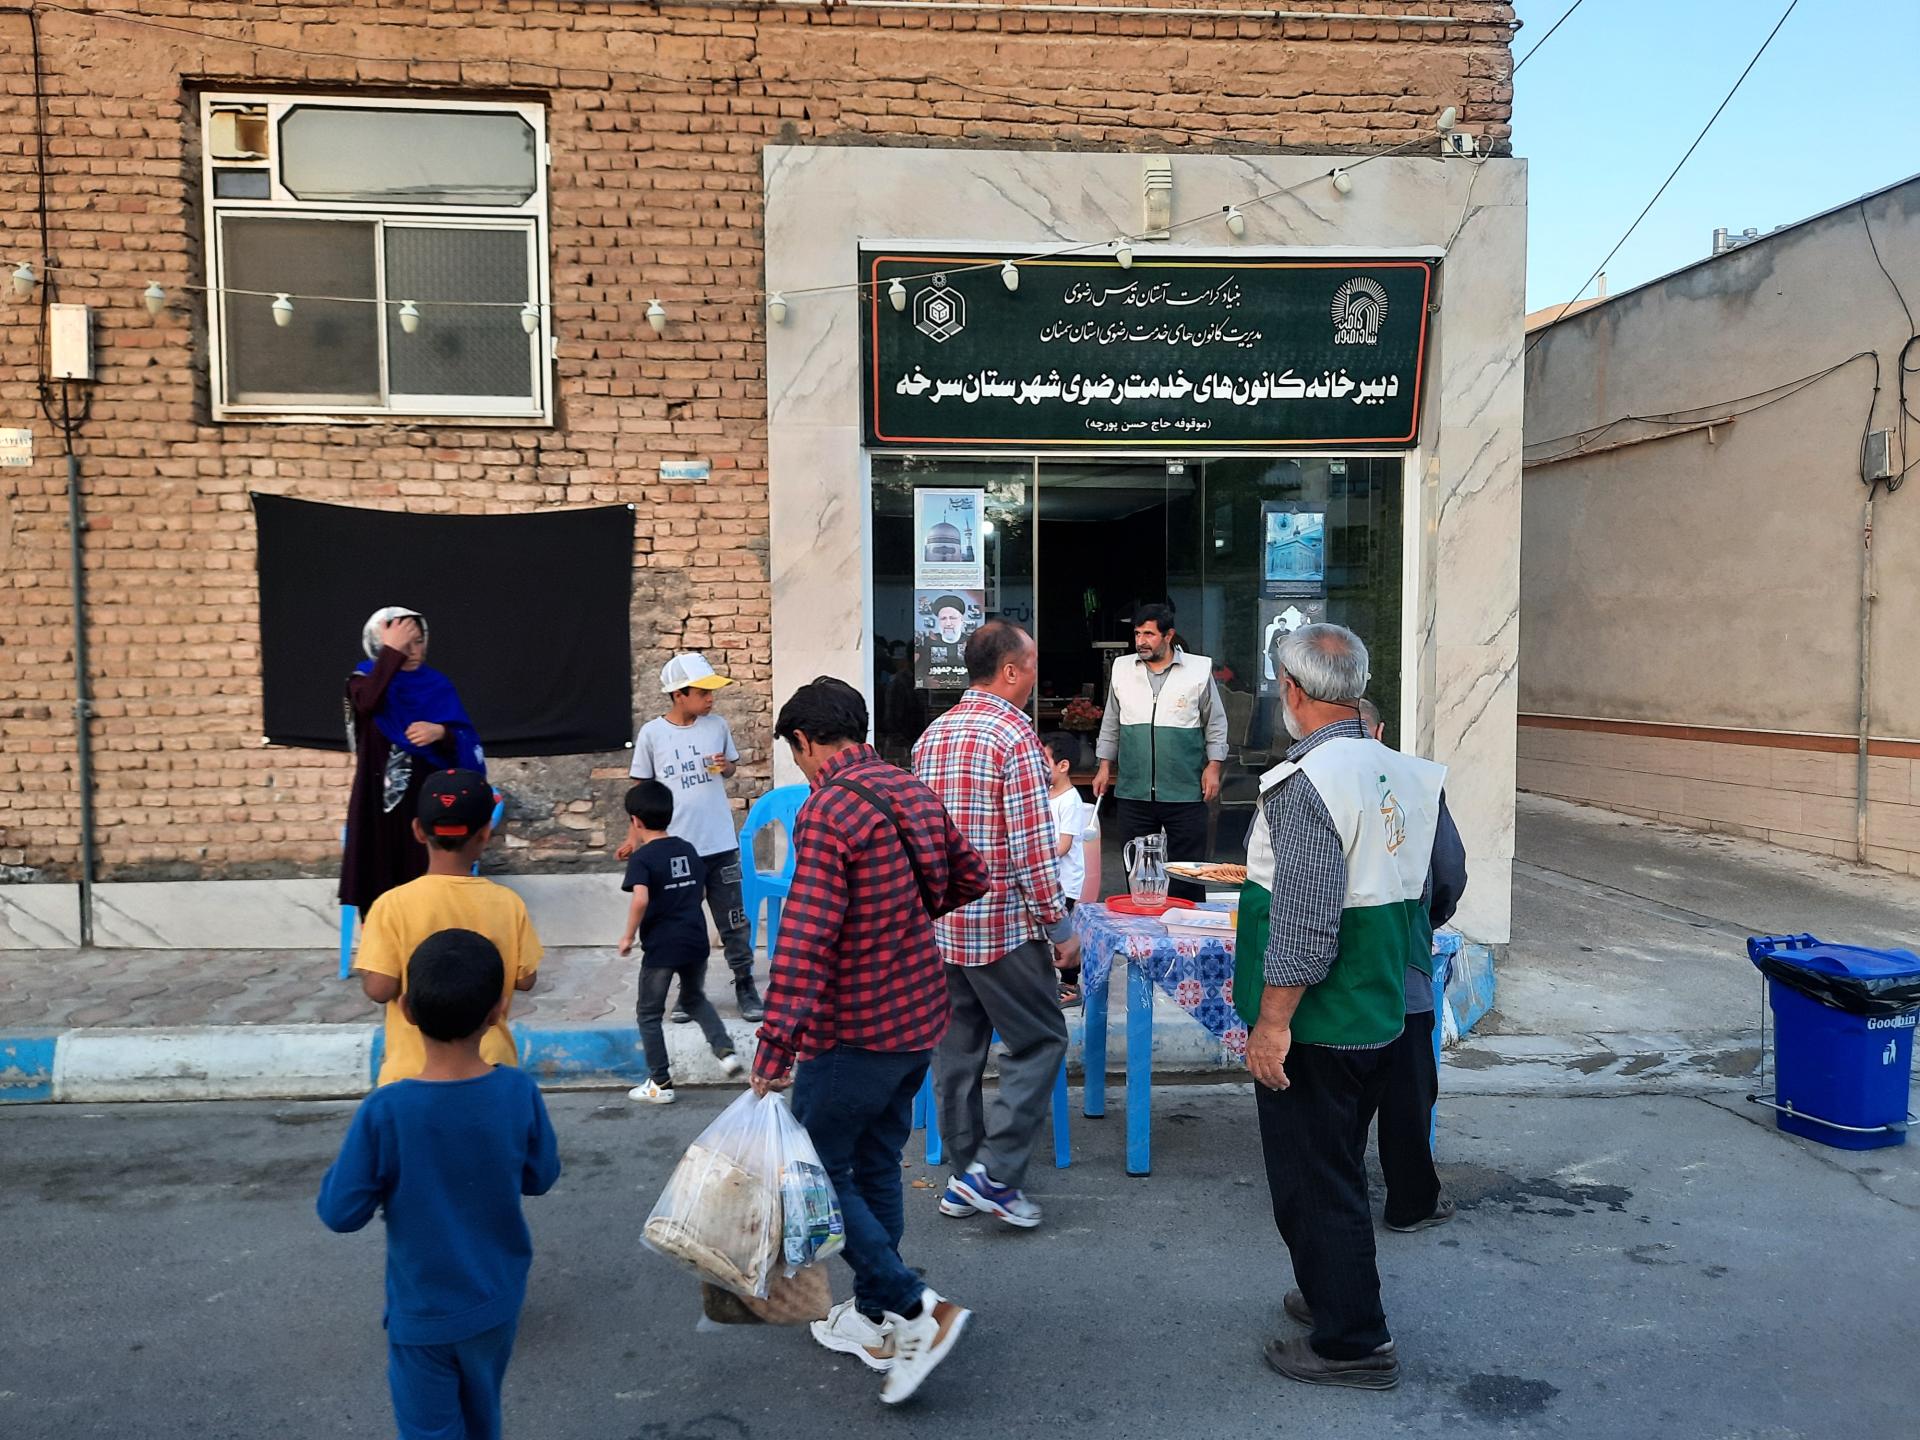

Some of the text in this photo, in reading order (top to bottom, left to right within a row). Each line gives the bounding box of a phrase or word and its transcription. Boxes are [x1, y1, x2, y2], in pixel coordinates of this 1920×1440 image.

[1064, 275, 1241, 309] بنیاد کرامت آستان قدس رضوی
[1040, 320, 1072, 342] سمنان
[1069, 321, 1100, 343] استان
[1099, 321, 1129, 345] رضوی
[1128, 323, 1169, 341] خدمت
[1222, 328, 1262, 348] مدیریت
[896, 365, 963, 404] سرخه
[962, 368, 1062, 405] شهرستان
[1061, 373, 1125, 405] رضوی
[1124, 368, 1194, 399] خدمت
[1305, 368, 1399, 404] دبیرخانه
[1121, 420, 1148, 432] حسن
[1151, 418, 1172, 432] حاج
